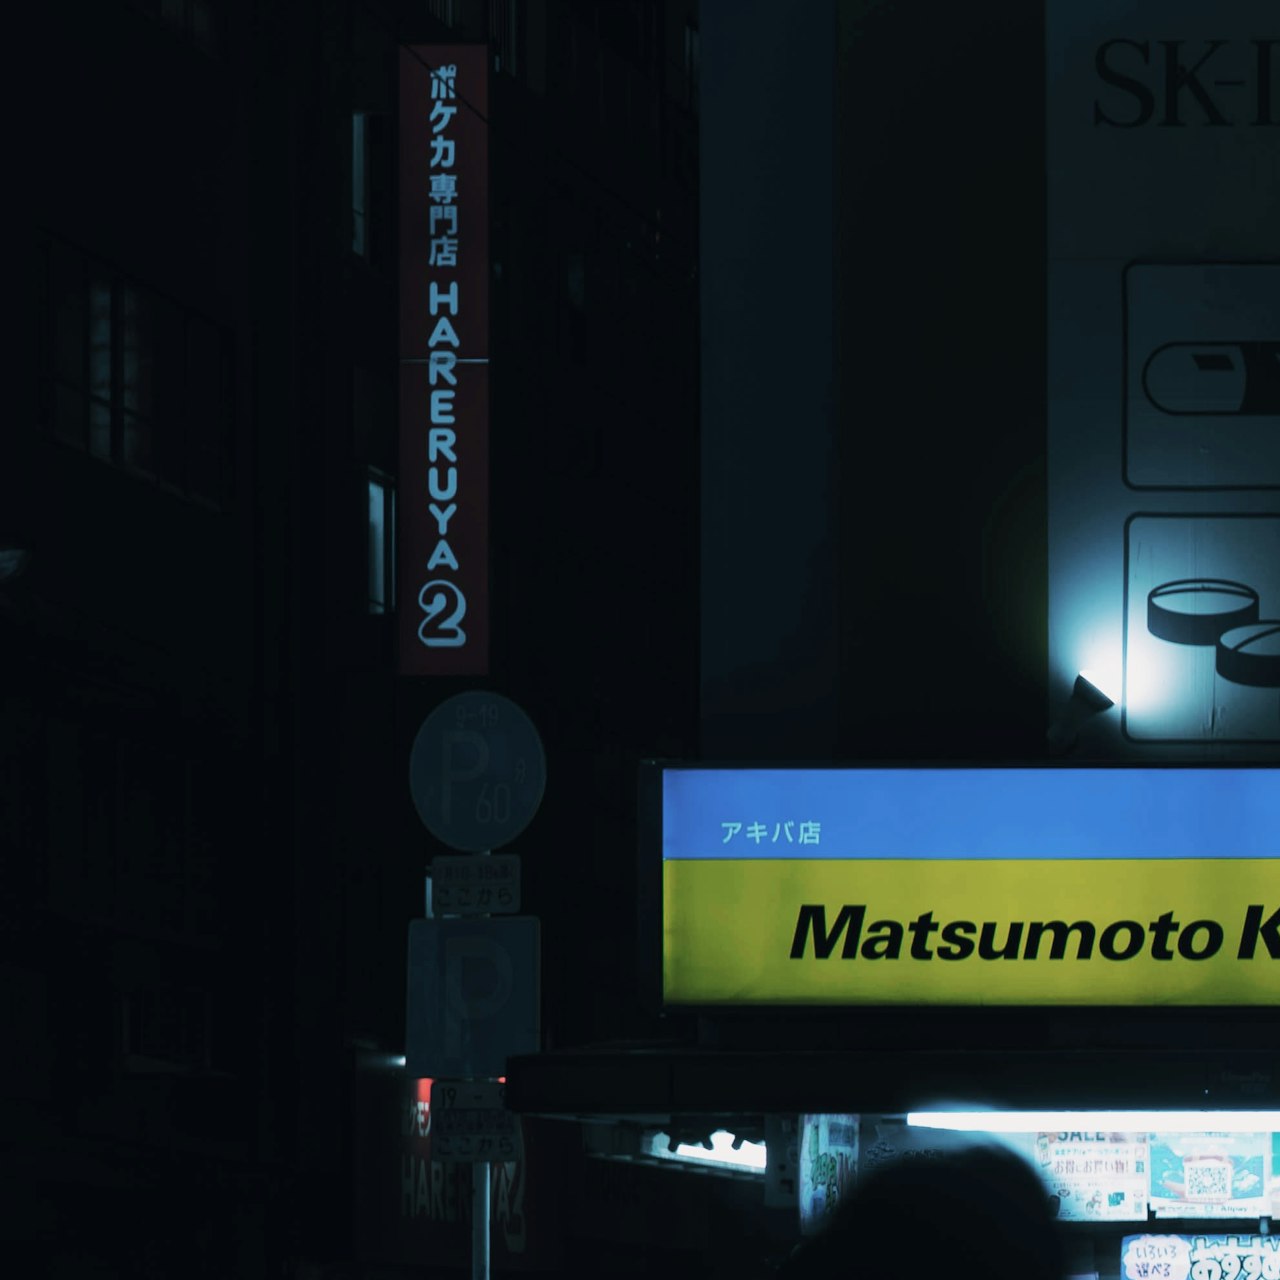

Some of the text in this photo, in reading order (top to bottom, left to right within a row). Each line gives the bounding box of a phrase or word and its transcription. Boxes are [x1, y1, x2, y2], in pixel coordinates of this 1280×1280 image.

[428, 63, 460, 268] ポケカ専門店
[427, 281, 461, 572] HARERUYA
[442, 729, 490, 825] P
[720, 821, 822, 846] アキバ店
[789, 903, 1224, 961] Matsumoto
